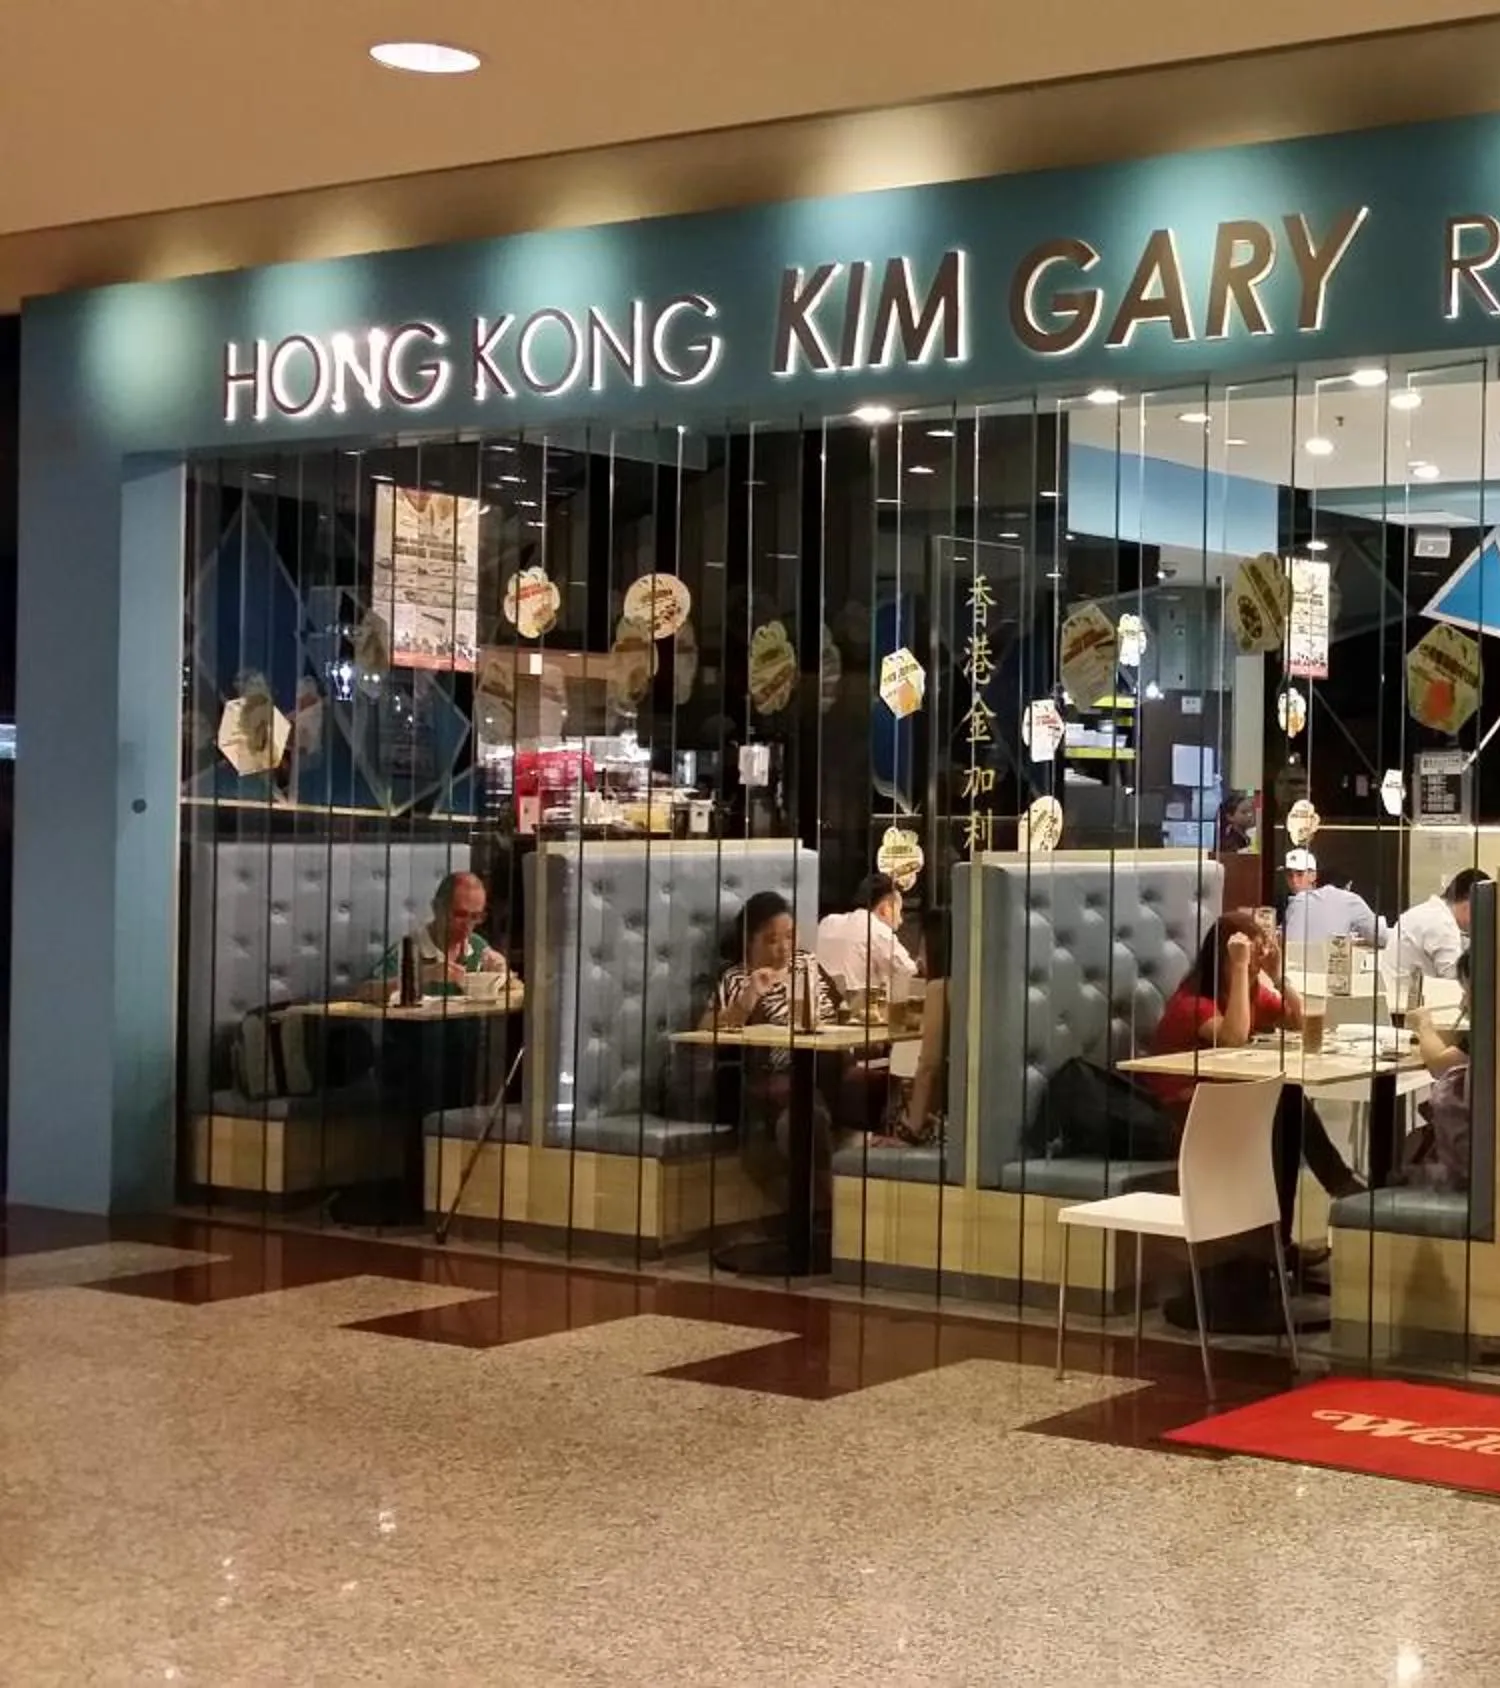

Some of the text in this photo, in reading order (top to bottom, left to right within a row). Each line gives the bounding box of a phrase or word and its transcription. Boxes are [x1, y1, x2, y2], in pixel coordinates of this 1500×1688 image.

[223, 322, 450, 422] HONG
[473, 294, 720, 401] KONG
[772, 250, 966, 376] KIM
[1008, 206, 1369, 356] GARY
[961, 574, 997, 852] 香港金加利
